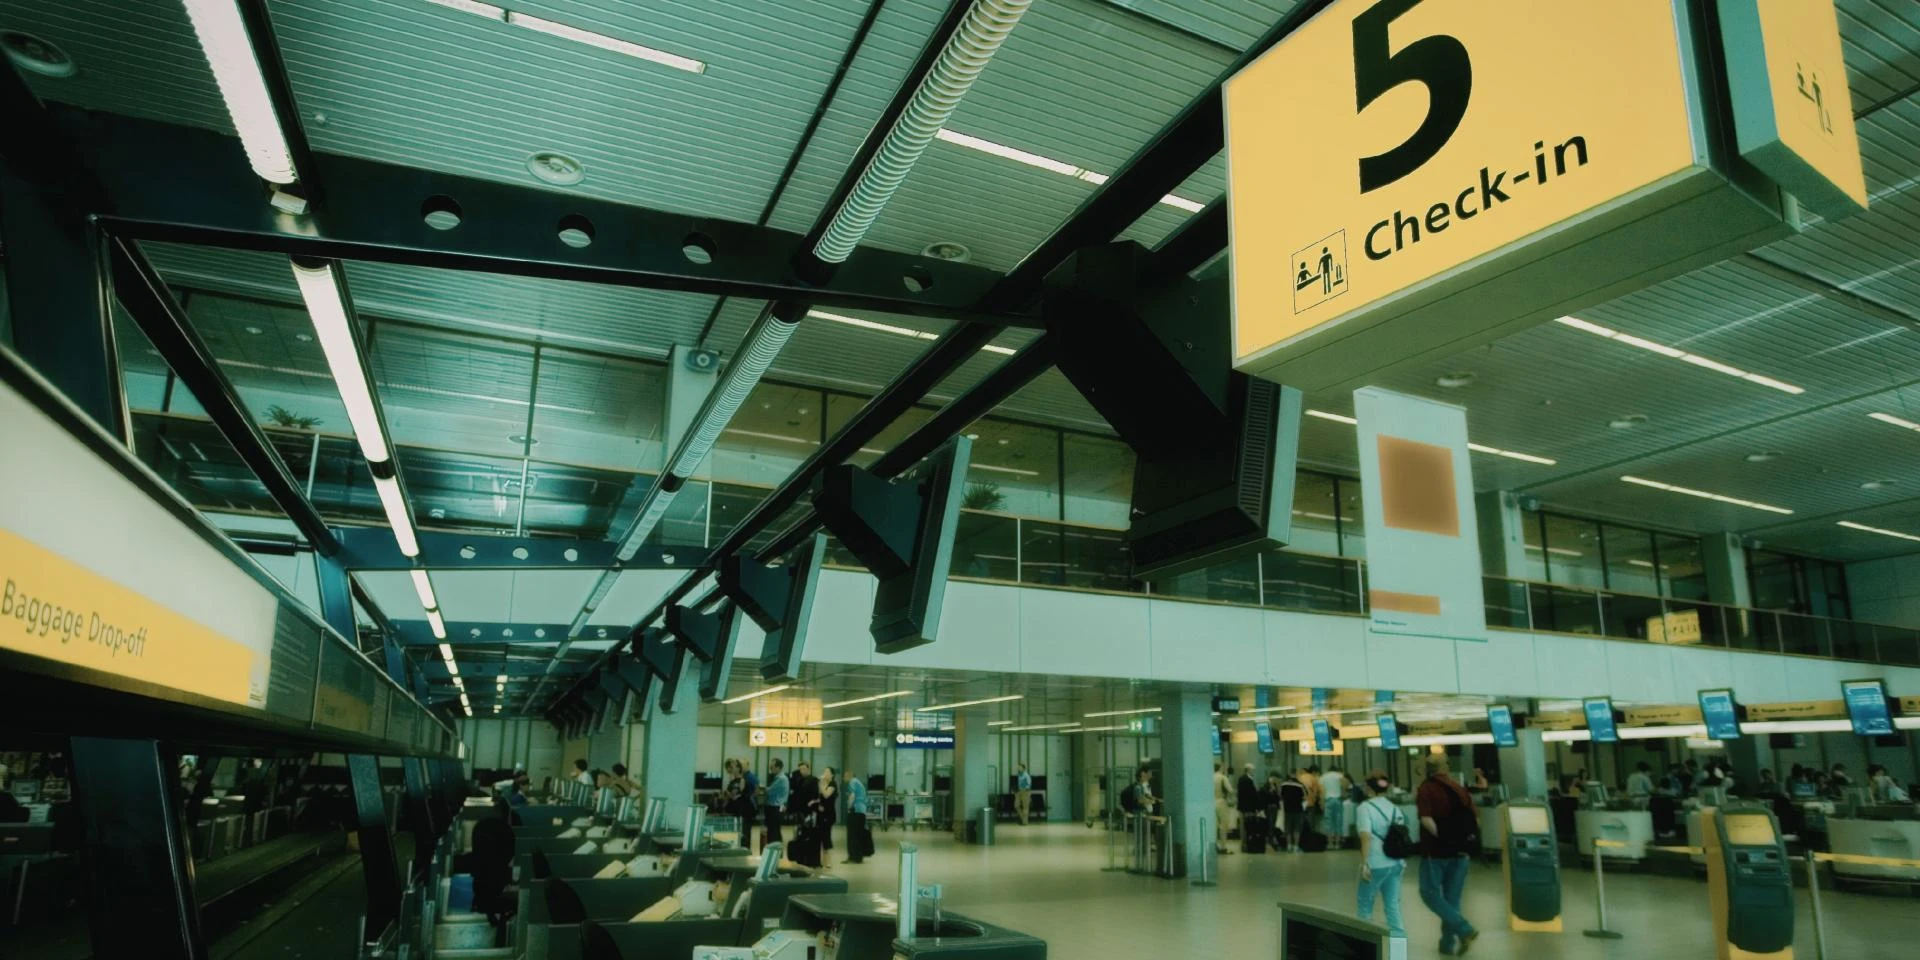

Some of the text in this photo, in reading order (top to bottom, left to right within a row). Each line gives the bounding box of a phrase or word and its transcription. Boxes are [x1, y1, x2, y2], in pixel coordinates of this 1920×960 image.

[1352, 0, 1473, 195] 5
[1364, 135, 1588, 261] Check-in
[1, 577, 148, 658] Baggage Drop-off
